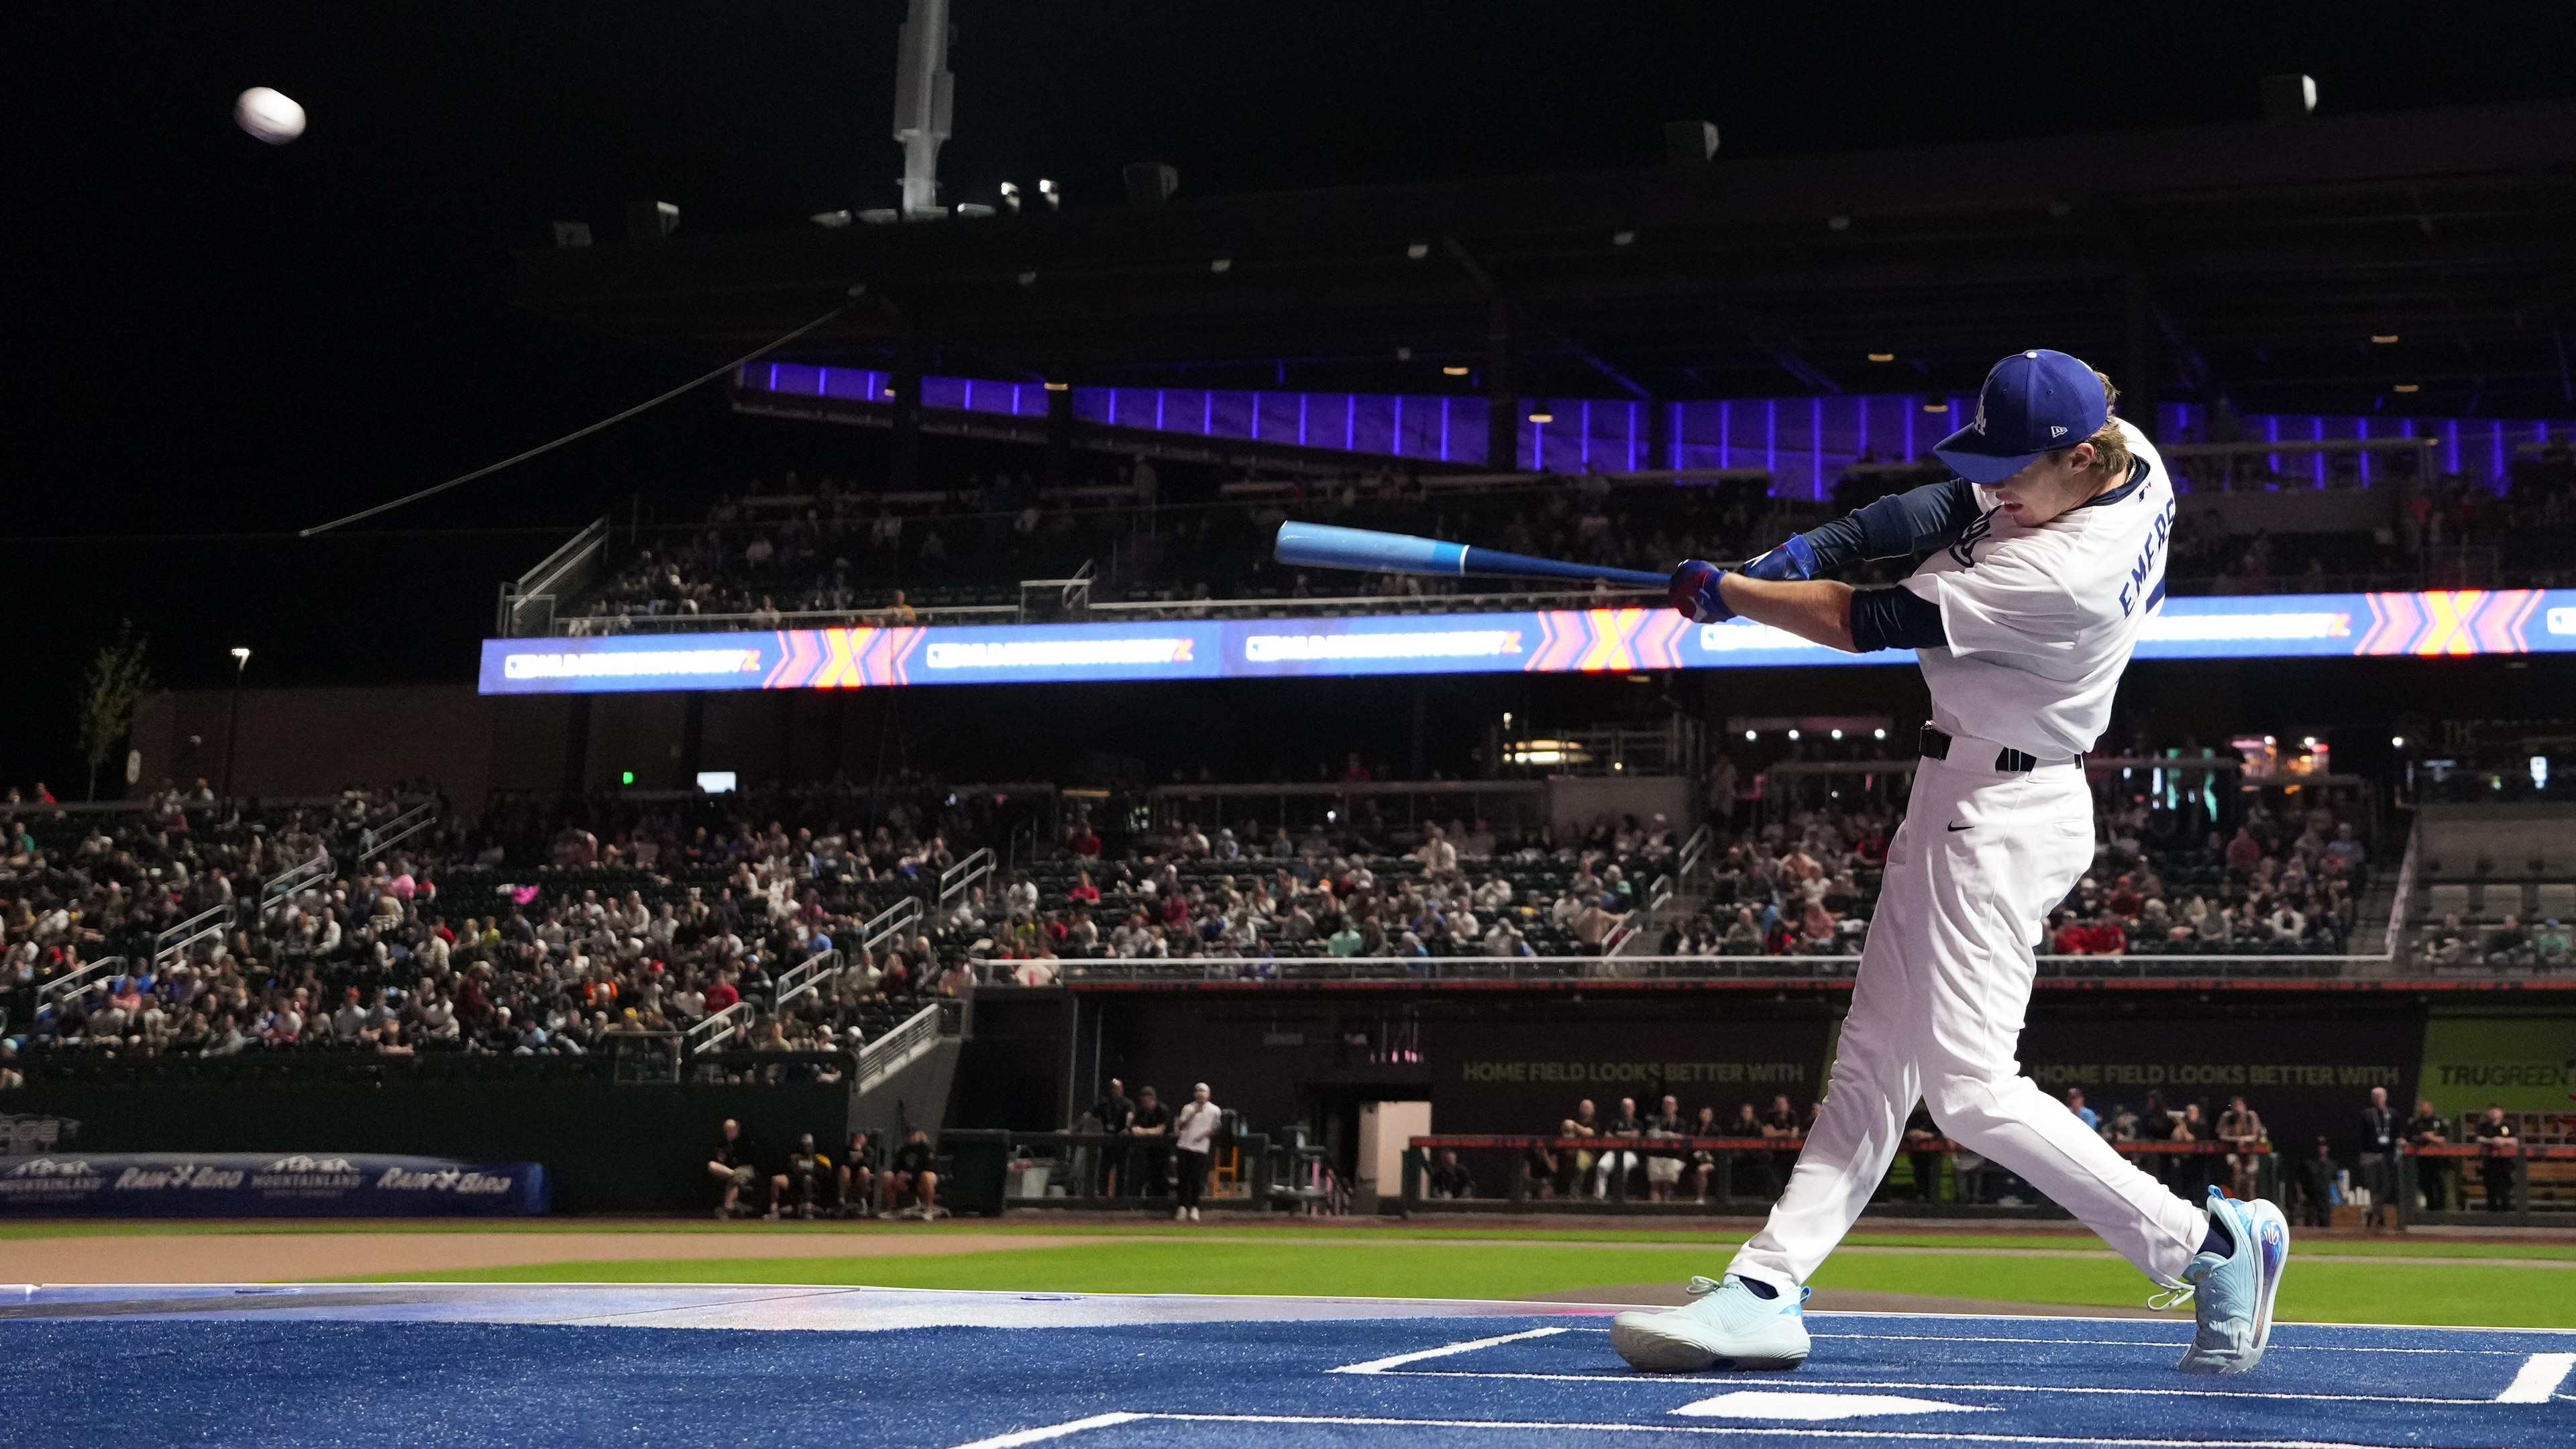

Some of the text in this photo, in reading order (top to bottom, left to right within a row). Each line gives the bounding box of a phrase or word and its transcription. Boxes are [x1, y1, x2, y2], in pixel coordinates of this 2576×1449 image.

[1462, 1061, 1805, 1083] HOME FIELD LOOKS BETTER WITH
[2034, 1064, 2400, 1087] HOME FIELD LOOKS BETTER WITH
[2438, 1065, 2569, 1086] TRUGREEN
